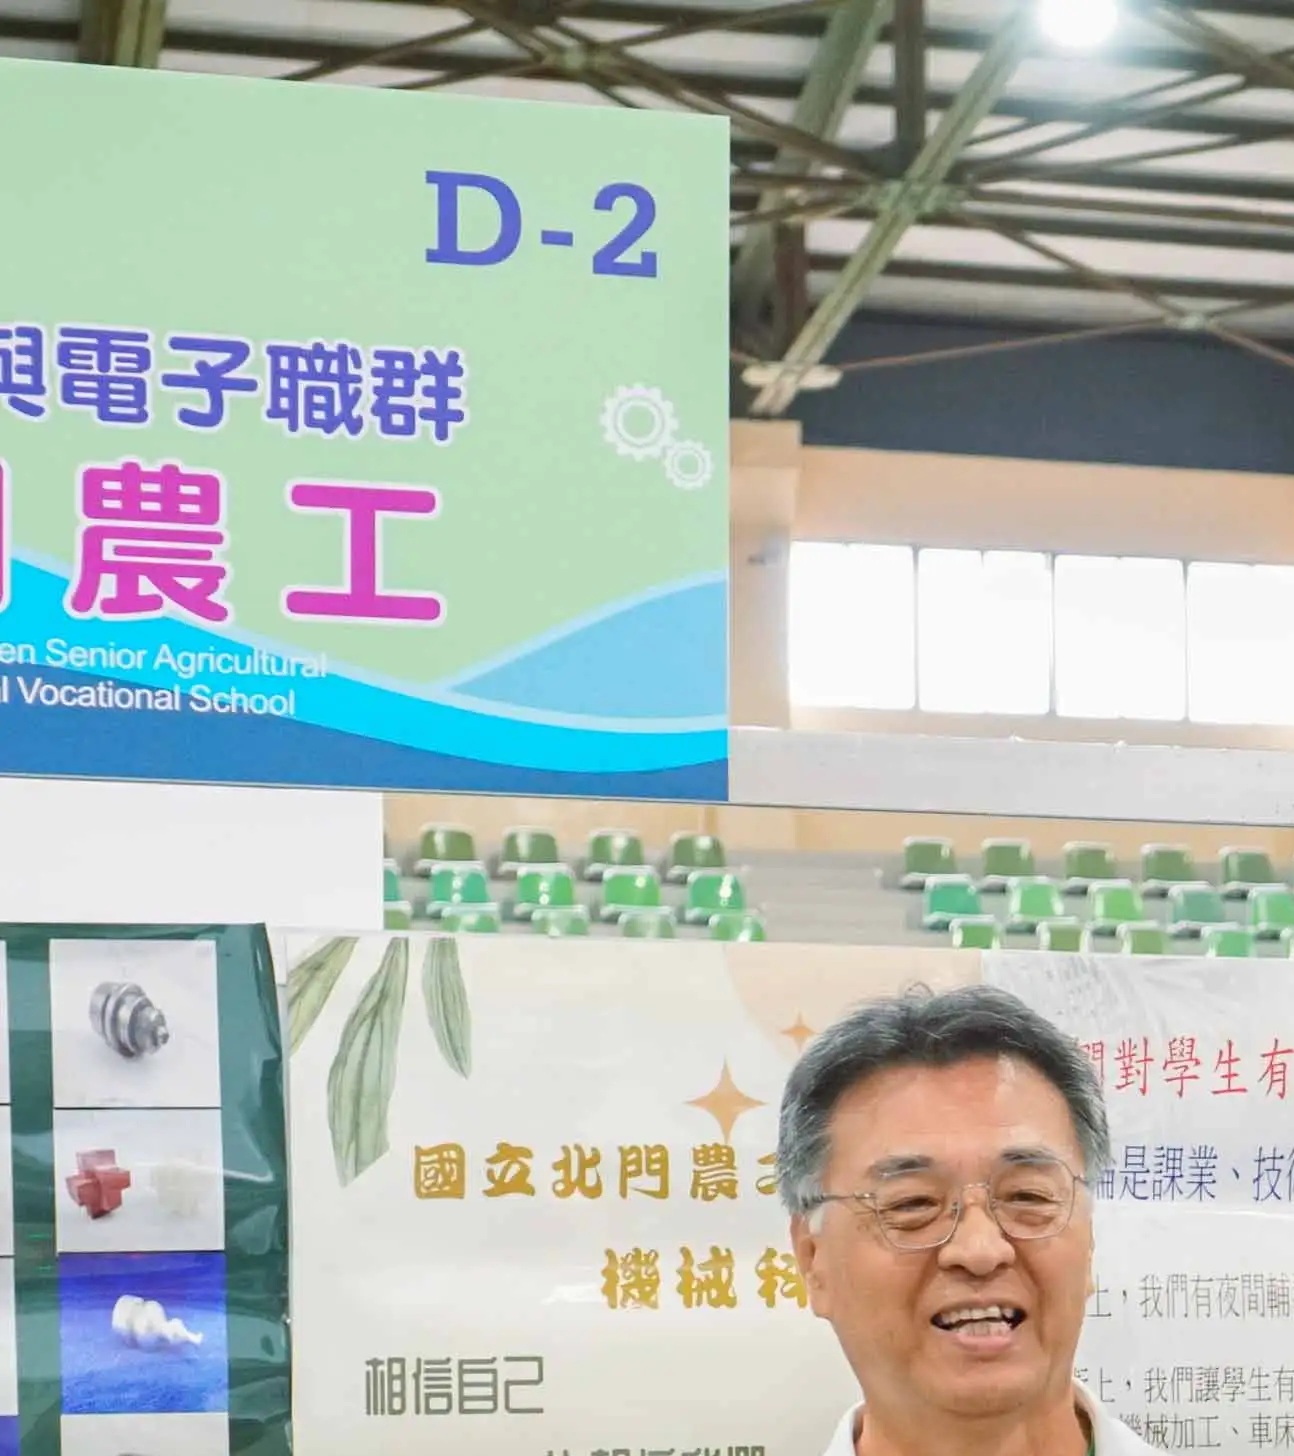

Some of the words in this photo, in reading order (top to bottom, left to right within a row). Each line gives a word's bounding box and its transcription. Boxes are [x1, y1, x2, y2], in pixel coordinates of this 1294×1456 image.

[424, 170, 658, 279] D-2
[0, 461, 442, 623] 農工
[45, 637, 148, 671] Senior
[153, 642, 328, 681] Agricultural
[16, 675, 181, 712] Vocational
[189, 683, 297, 717] School
[364, 1356, 545, 1416] 相信自己
